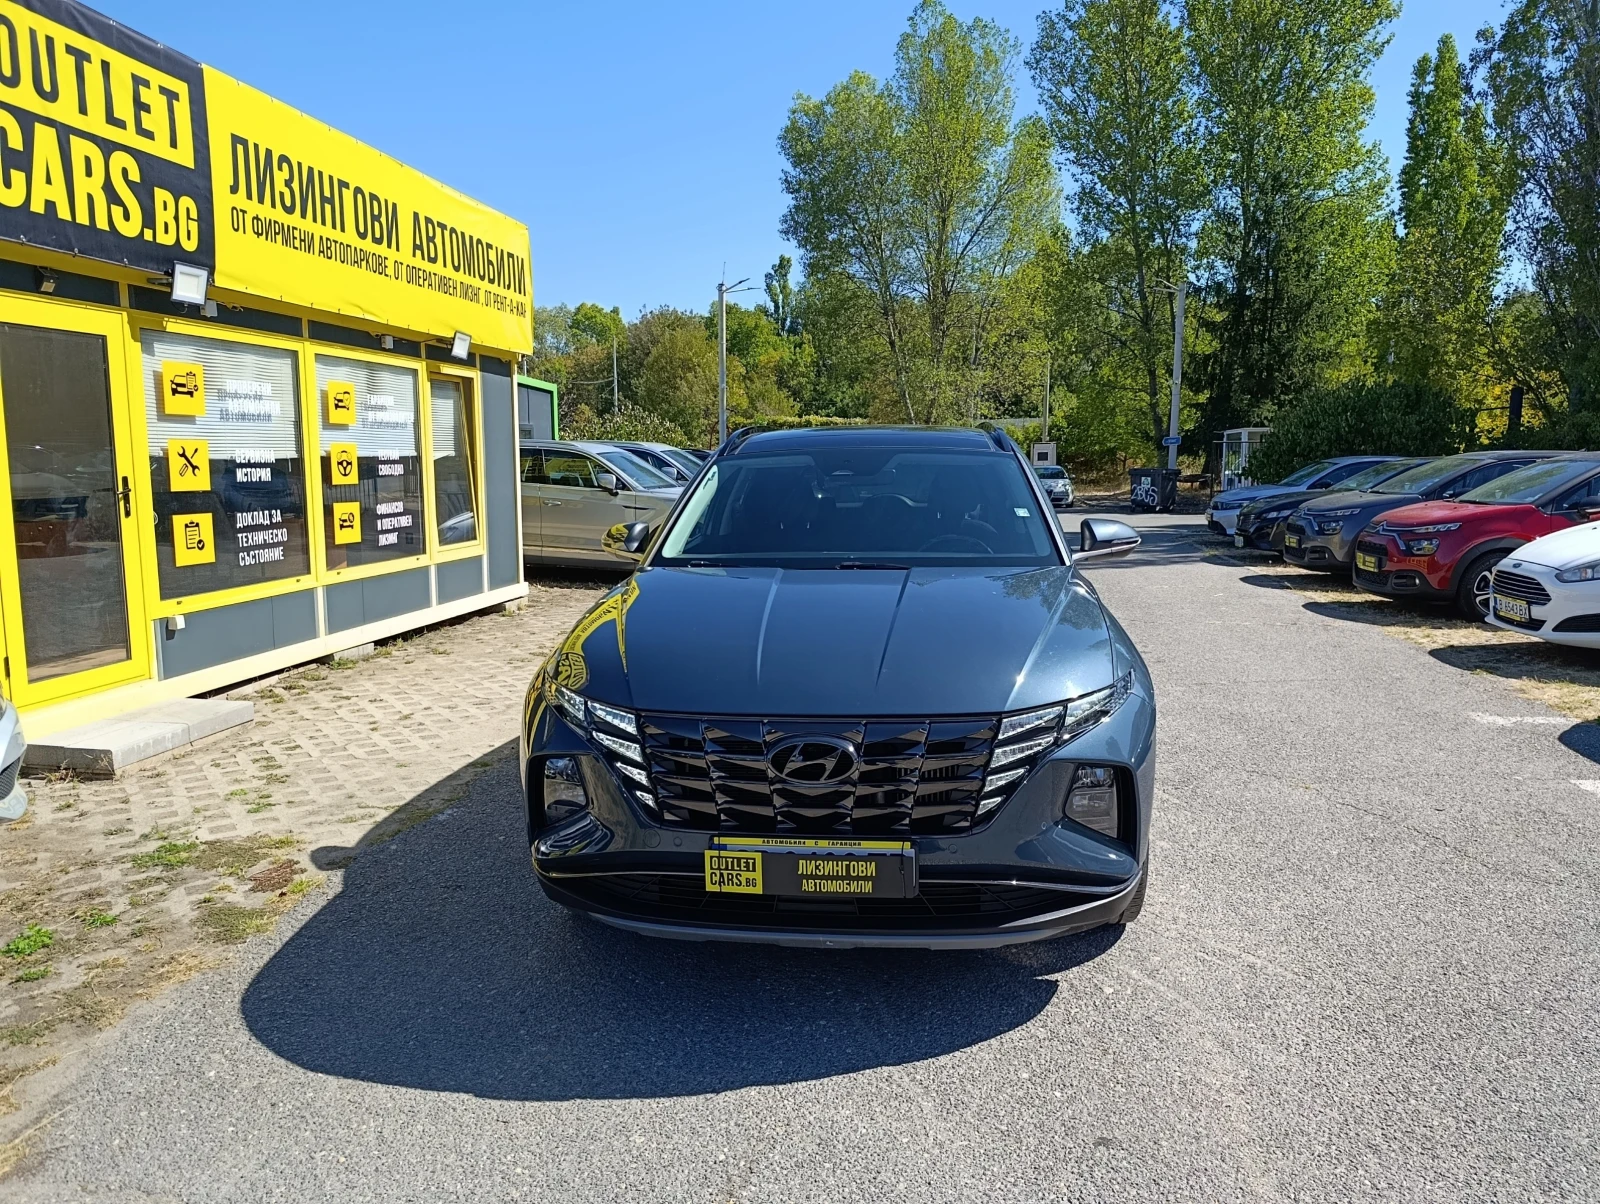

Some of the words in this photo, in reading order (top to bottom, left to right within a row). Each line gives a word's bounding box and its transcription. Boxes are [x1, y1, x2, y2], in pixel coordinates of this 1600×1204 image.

[0, 13, 180, 150] OUTLET
[0, 108, 199, 252] CARS.BG
[229, 133, 400, 253] ЛИЗИНГОВИ
[412, 210, 527, 297] АВТОМОБИЛИ
[231, 206, 247, 235] ОТ
[252, 214, 315, 255] ФИРМЕНИ
[318, 235, 392, 281] АВТОПАРКОВЕ,
[393, 259, 404, 282] ОТ
[405, 264, 458, 298] ОПЕРАТИВЕН
[484, 290, 492, 308] ОТ
[235, 449, 276, 464] СЕРВИЗНА
[236, 467, 272, 483] ИСТОРИЯ
[378, 463, 404, 477] СВОБОДНО
[376, 500, 404, 516] ФИНАНСОВ
[236, 510, 271, 529] ДОКЛАД
[271, 509, 282, 523] ЗА
[382, 514, 413, 531] ОПЕРАТИВЕН
[237, 527, 288, 548] ТЕХНИЧЕСКО
[238, 546, 285, 567] СЪСТОЯНИЕ
[762, 838, 807, 846] АВТОМОБИЛИ
[827, 840, 862, 848] ГАРАНЦИЯ
[711, 857, 755, 871] OUTLET
[797, 859, 876, 877] ЛИЗИНГОВИ
[709, 871, 757, 888] CARS.BG
[801, 878, 873, 894] АВТОМОБИЛИ
